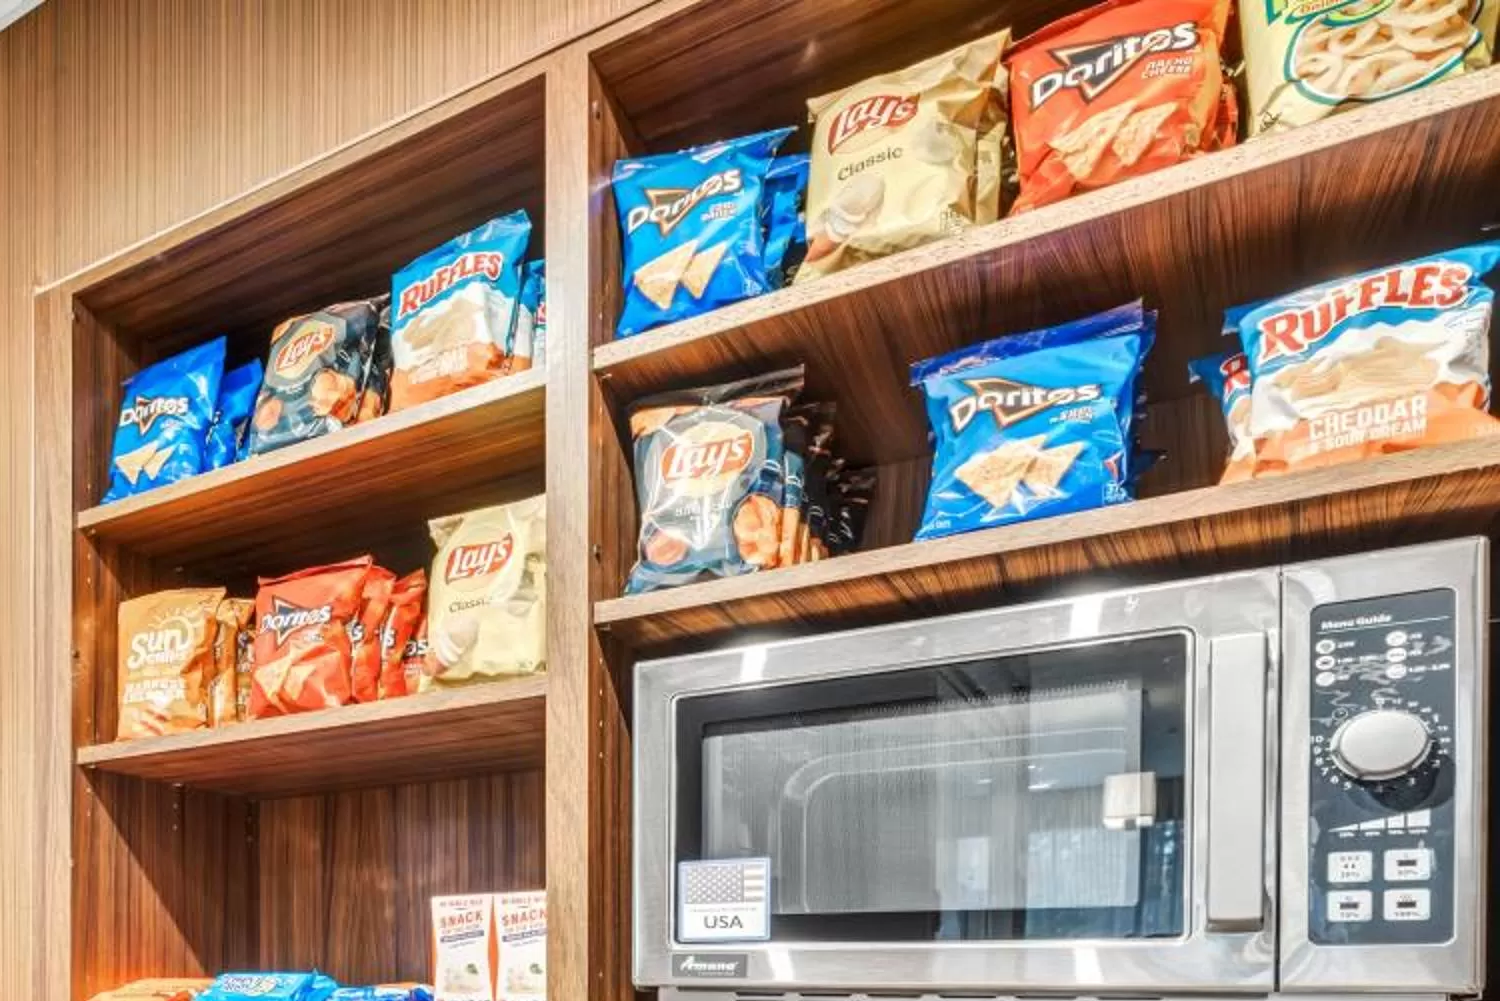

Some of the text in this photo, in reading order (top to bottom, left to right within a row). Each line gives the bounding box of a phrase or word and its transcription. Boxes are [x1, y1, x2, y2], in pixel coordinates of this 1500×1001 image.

[1029, 20, 1198, 110] Doritos
[837, 145, 904, 182] Classic
[627, 167, 742, 233] Doritos
[400, 252, 503, 317] RUFFLES
[1260, 265, 1469, 360] RUFFLES
[119, 396, 189, 427] Doritos
[950, 382, 1101, 433] Doritos
[1308, 395, 1428, 441] CHEDDAR
[703, 915, 743, 929] USA
